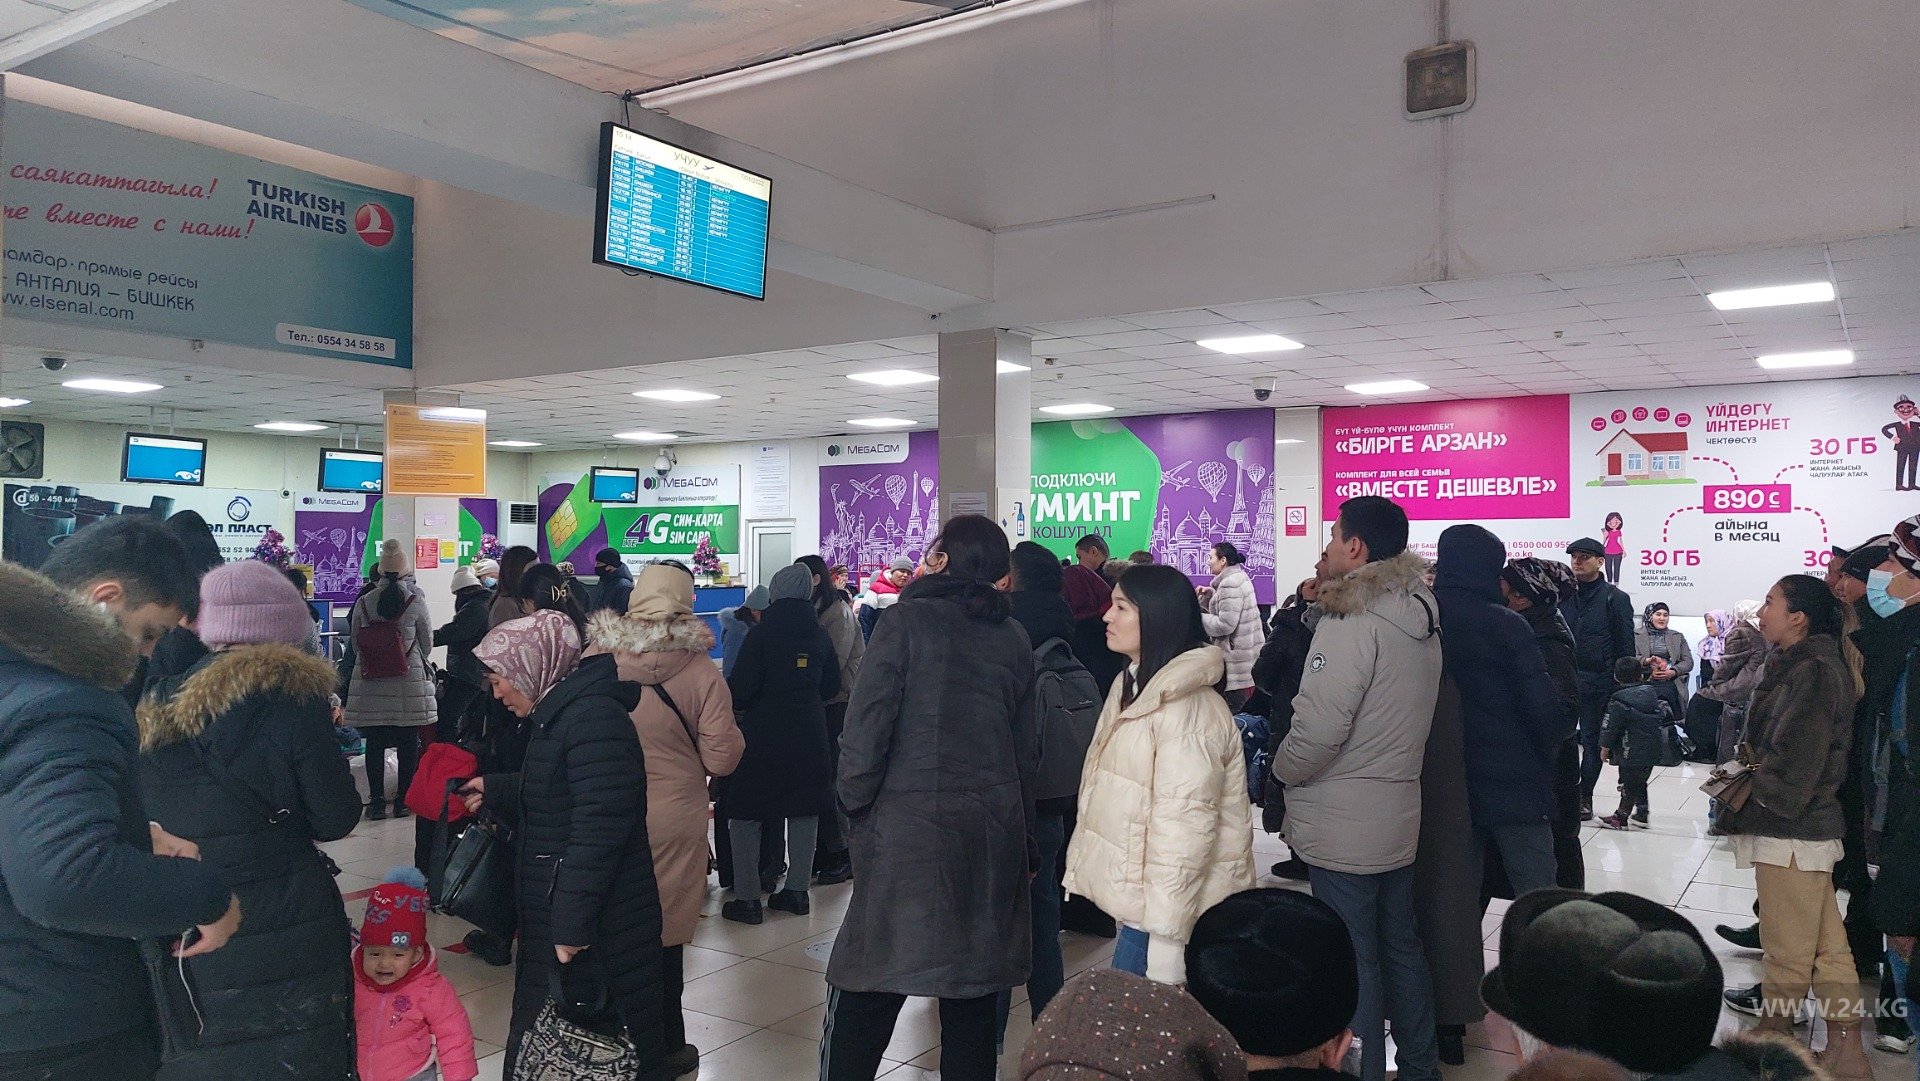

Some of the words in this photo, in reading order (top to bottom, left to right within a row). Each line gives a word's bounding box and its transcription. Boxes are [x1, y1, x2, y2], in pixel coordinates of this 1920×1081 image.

[9, 164, 219, 199] саякаттагыла!
[247, 180, 345, 216] TURKISH
[46, 203, 139, 230] вместе
[154, 217, 167, 231] с
[180, 219, 255, 239] нами!
[247, 200, 347, 235] AIRLINES
[78, 260, 142, 280] прямые
[148, 271, 198, 289] рейсы
[16, 272, 100, 297] АНТАЛИЯ
[128, 288, 195, 311] БИШКЕК
[288, 330, 314, 343] Тел.:
[317, 334, 342, 346] 0554
[344, 336, 356, 348] 34
[359, 339, 371, 350] 58
[374, 341, 385, 352] 58
[1706, 418, 1791, 433] ИНТЕРНЕТ
[1335, 435, 1413, 455] «БИРГЕ
[1421, 431, 1508, 453] АРЗАН»
[1810, 438, 1840, 456] 30
[1847, 437, 1877, 454] ГБ
[1335, 470, 1377, 479] КОМПЛЕКТ
[1380, 470, 1397, 478] ДЛЯ
[1399, 468, 1419, 477] ВСЕЙ
[1422, 468, 1450, 477] СЕМЬИ
[1335, 479, 1429, 499] «ВМЕСТЕ
[1436, 476, 1558, 499] ДЕШЕВЛЕ»
[1713, 489, 1765, 509] 890
[228, 523, 272, 533] ПЛАСТ
[625, 513, 672, 544] 4G
[673, 513, 723, 527] СИМ-КАРТА
[1715, 519, 1768, 530] айына
[669, 531, 686, 545] SIM
[1513, 541, 1534, 549] 0500
[1714, 533, 1723, 541] в
[1729, 532, 1780, 543] месяц
[1640, 550, 1667, 566] 30
[1673, 550, 1700, 566] ГБ
